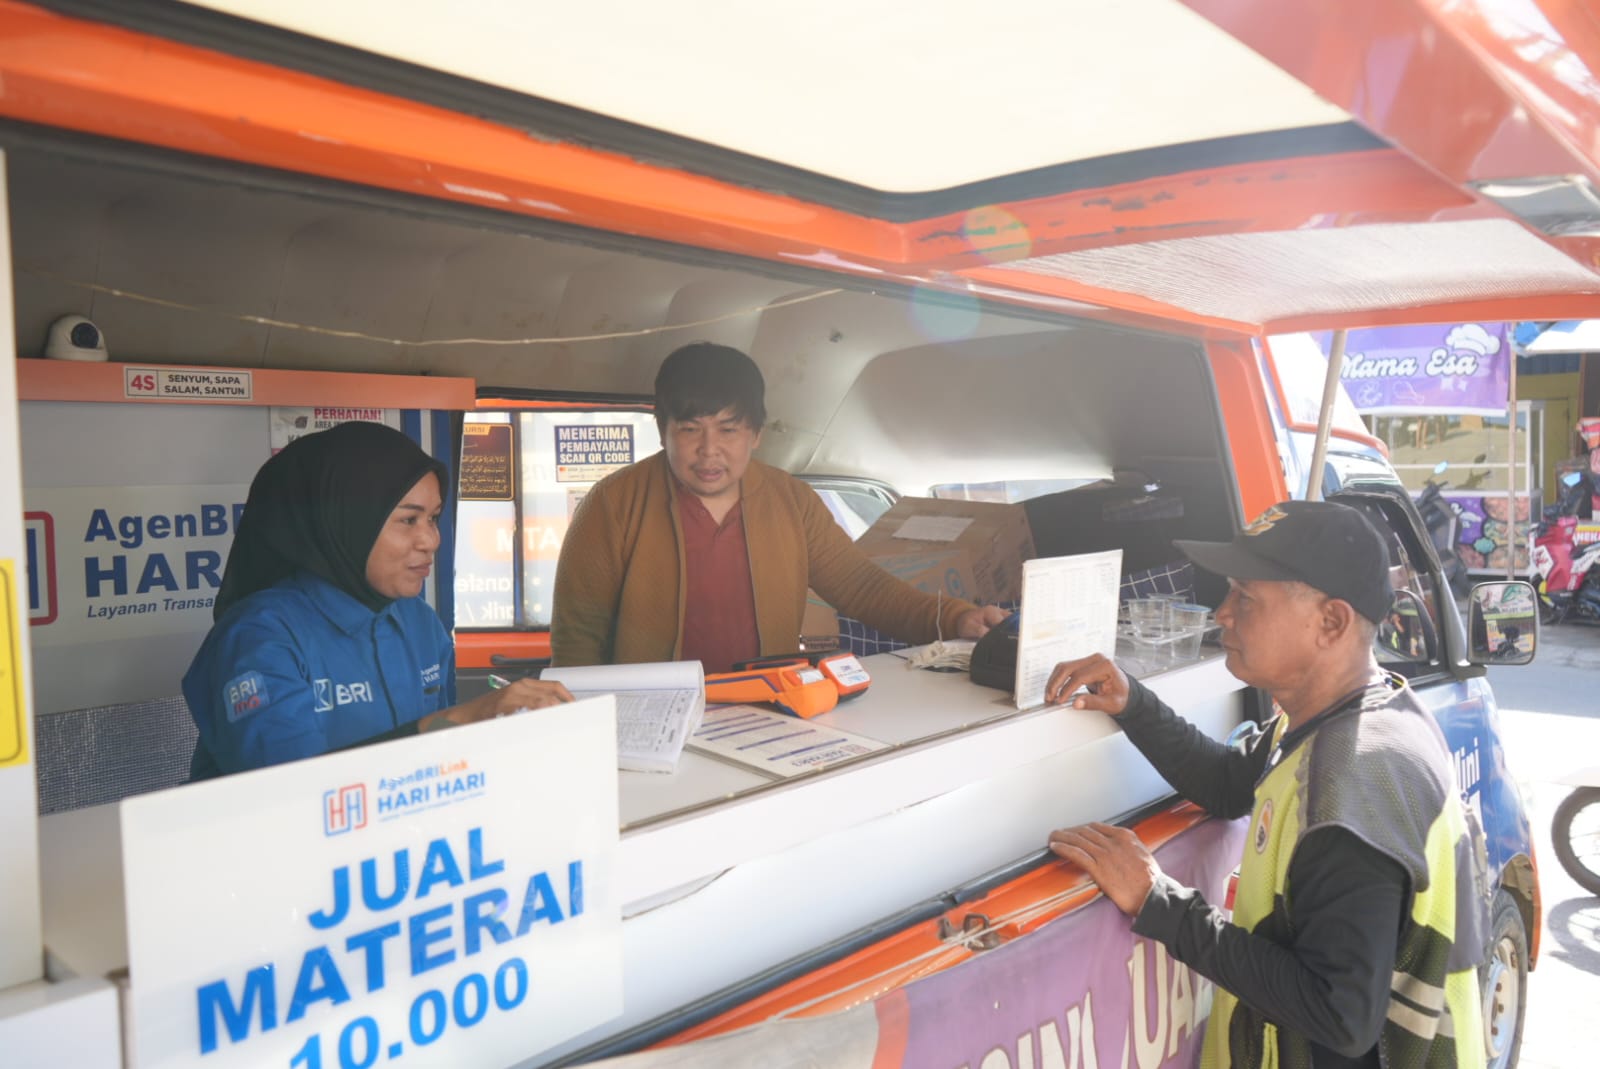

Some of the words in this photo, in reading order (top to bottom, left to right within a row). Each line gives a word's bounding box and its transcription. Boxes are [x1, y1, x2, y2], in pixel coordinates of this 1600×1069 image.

[1427, 348, 1478, 377] Esa
[131, 374, 155, 391] 4S
[164, 385, 202, 395] SALAM,
[204, 386, 245, 395] SANTUN
[168, 374, 213, 384] SENYUM,
[314, 408, 382, 420] PERHATIAN!
[559, 427, 629, 441] MENERIMA
[560, 441, 630, 453] PEMBAYARAN
[560, 453, 586, 463] SCAN
[589, 453, 602, 464] QR
[605, 452, 631, 463] CODE
[84, 550, 222, 598] HAR
[87, 604, 157, 620] Layanan
[163, 596, 215, 611] Transa
[230, 678, 258, 704] BRI
[335, 681, 373, 705] BRI
[377, 786, 430, 814] HARI
[437, 772, 485, 797] HARI
[306, 827, 505, 931] JUAL
[196, 860, 584, 1056] MATERAI
[289, 957, 529, 1069] 10.000
